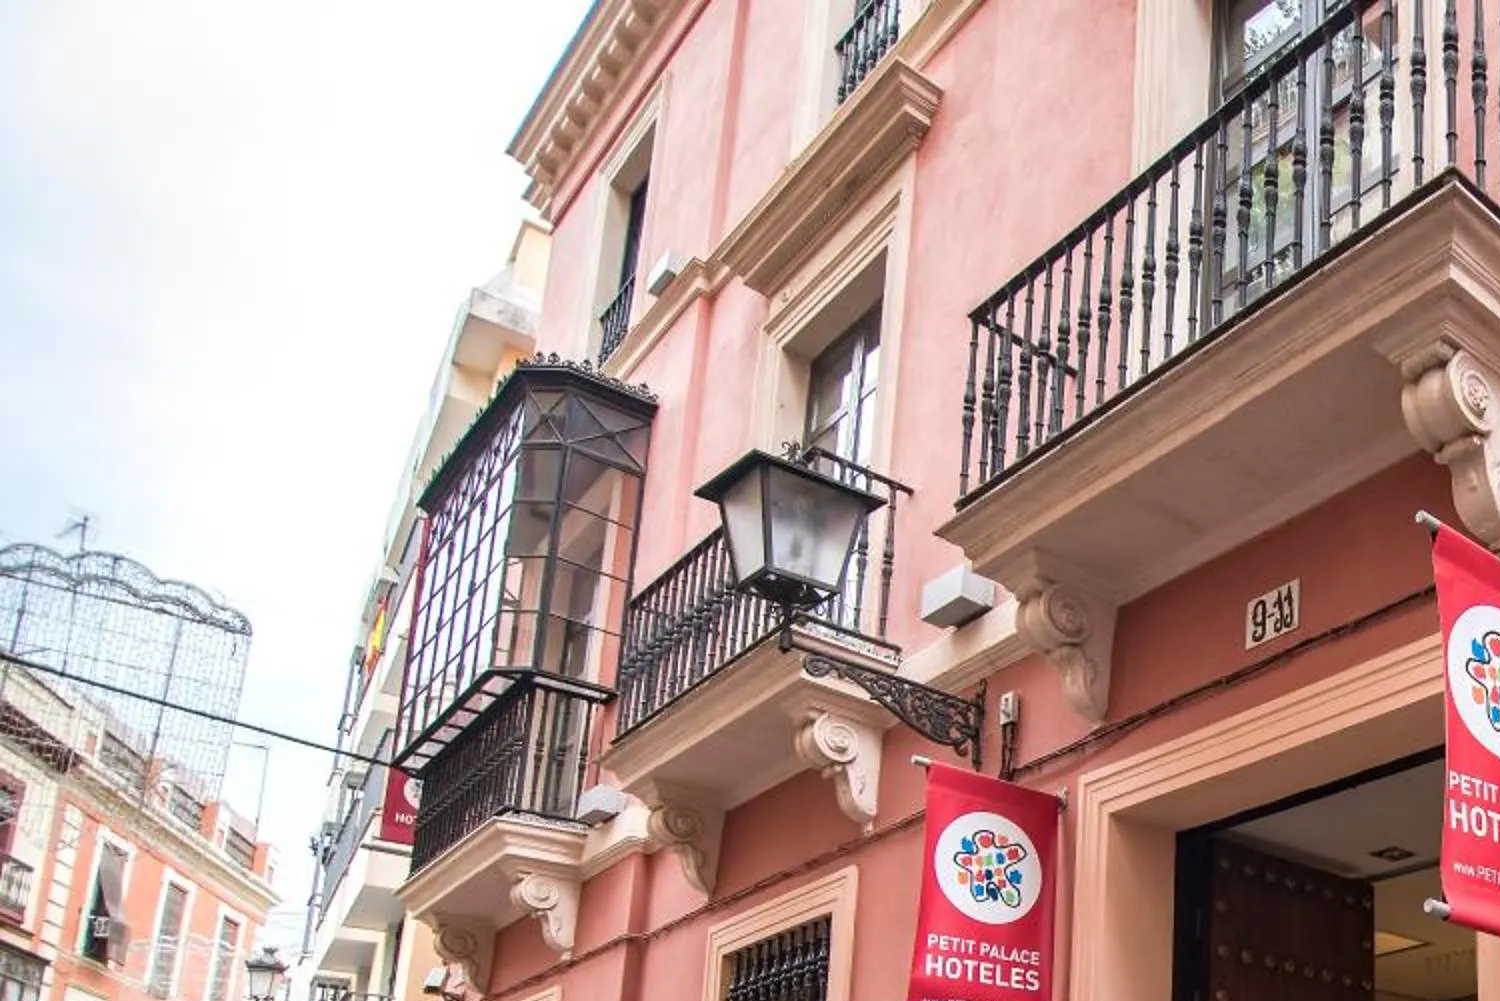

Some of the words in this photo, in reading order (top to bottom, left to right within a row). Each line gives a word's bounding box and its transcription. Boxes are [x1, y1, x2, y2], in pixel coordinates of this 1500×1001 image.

[1251, 584, 1294, 642] 9-11
[1448, 771, 1499, 804] PETIT
[927, 933, 976, 955] PETIT
[979, 942, 1040, 966] PALACE
[925, 954, 1040, 991] HOTELES
